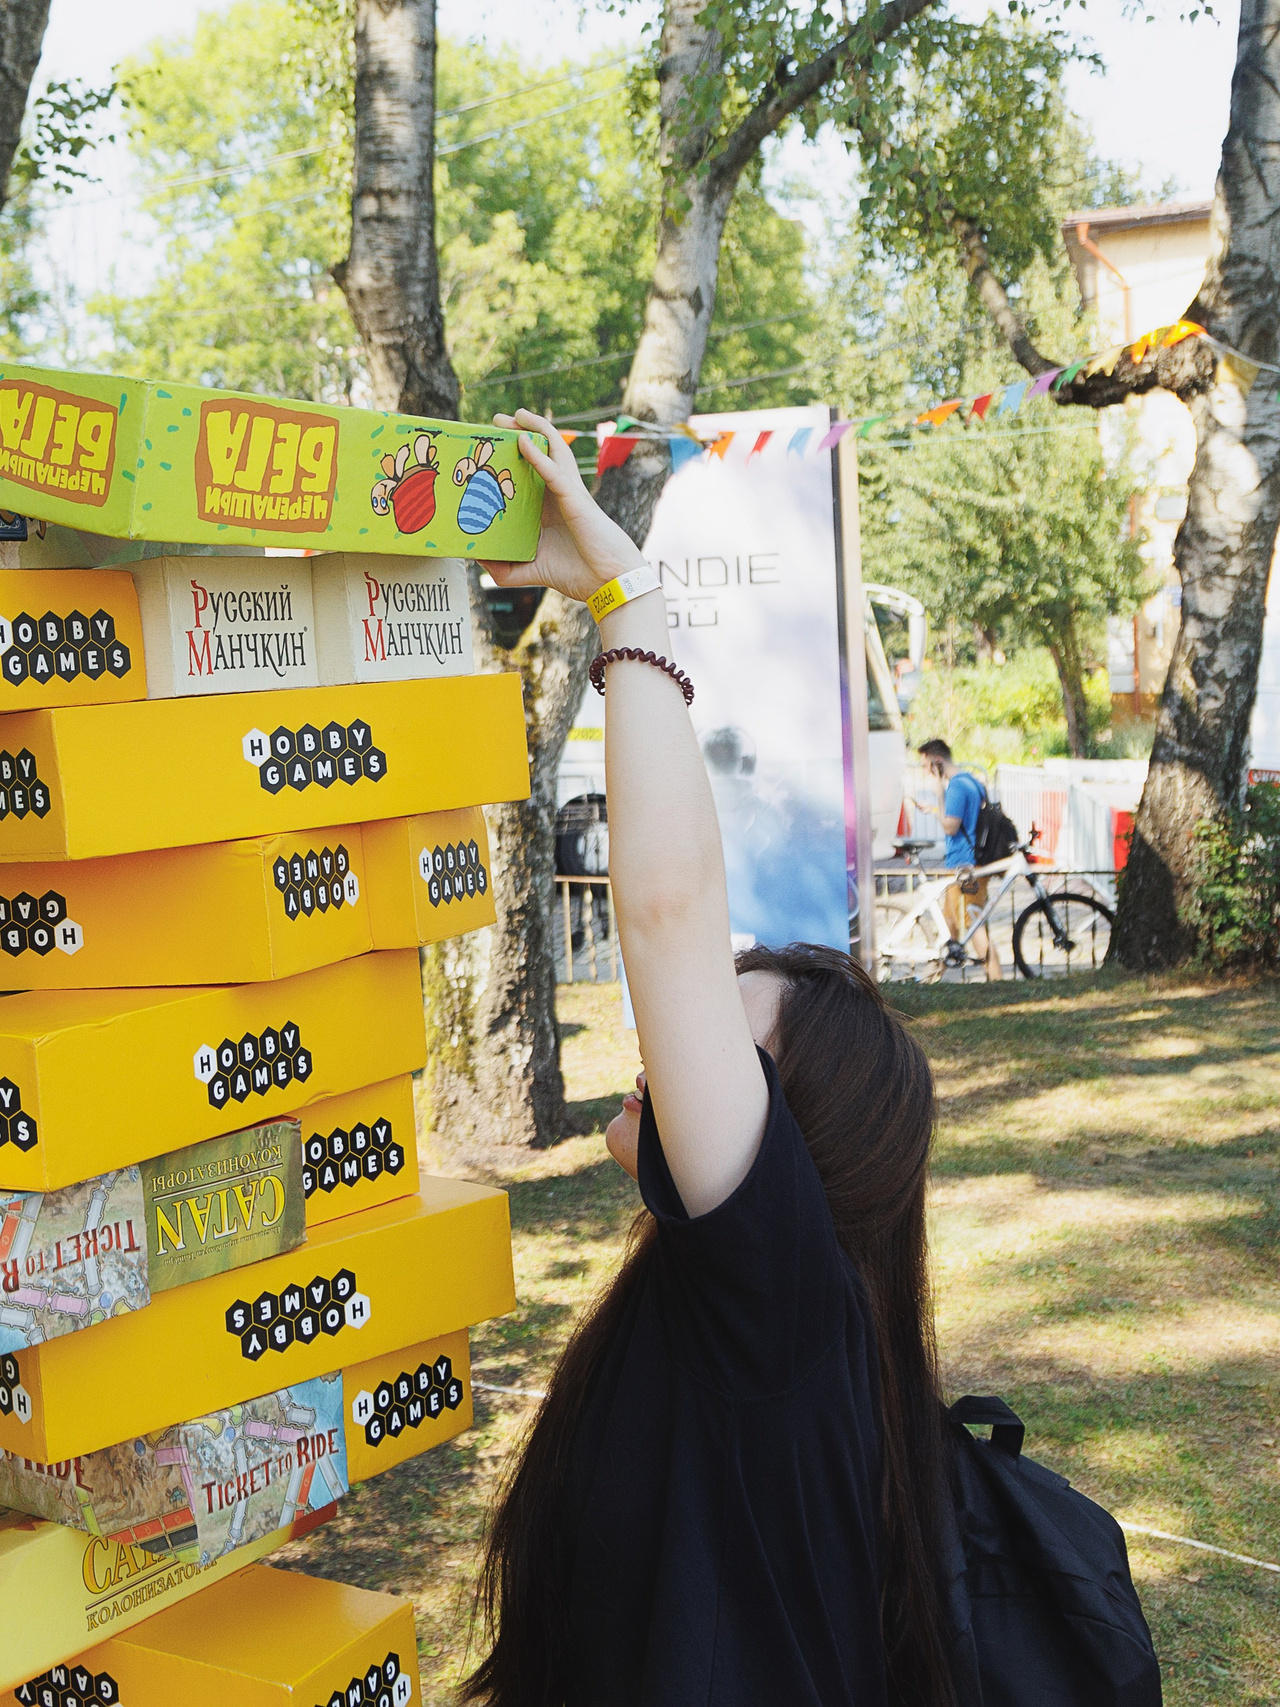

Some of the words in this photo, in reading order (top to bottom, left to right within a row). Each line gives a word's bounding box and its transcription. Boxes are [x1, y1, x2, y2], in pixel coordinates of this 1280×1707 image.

[206, 410, 337, 492] БЕГА
[205, 485, 328, 521] ЧЕРЕПАШЬИ
[648, 553, 779, 587] NDIE
[7, 648, 125, 675] GAMES
[249, 727, 366, 759] HOBBY
[265, 754, 381, 786] GAMES
[277, 853, 347, 885] GAMES
[422, 846, 477, 874] HOBBY
[287, 877, 357, 913] HOBBY
[431, 872, 486, 901] GAMES
[199, 1030, 297, 1074] HOBBY
[213, 1054, 308, 1100] GAMES
[310, 1125, 387, 1161] OBBY
[151, 1144, 283, 1194] КОЛОНИЗАТОРЫ
[303, 1150, 399, 1190] GAMES
[154, 1178, 286, 1257] CATAN
[25, 1252, 52, 1276] TO
[52, 1218, 141, 1276] TICKET
[232, 1276, 351, 1330] GAMES
[248, 1301, 364, 1352] HOBBY
[357, 1362, 451, 1419] HOBBY
[370, 1384, 459, 1439] GAMES
[201, 1459, 273, 1515] TICKET
[276, 1453, 292, 1473] TO
[297, 1427, 340, 1469] RIDE
[52, 1667, 113, 1699] GAM
